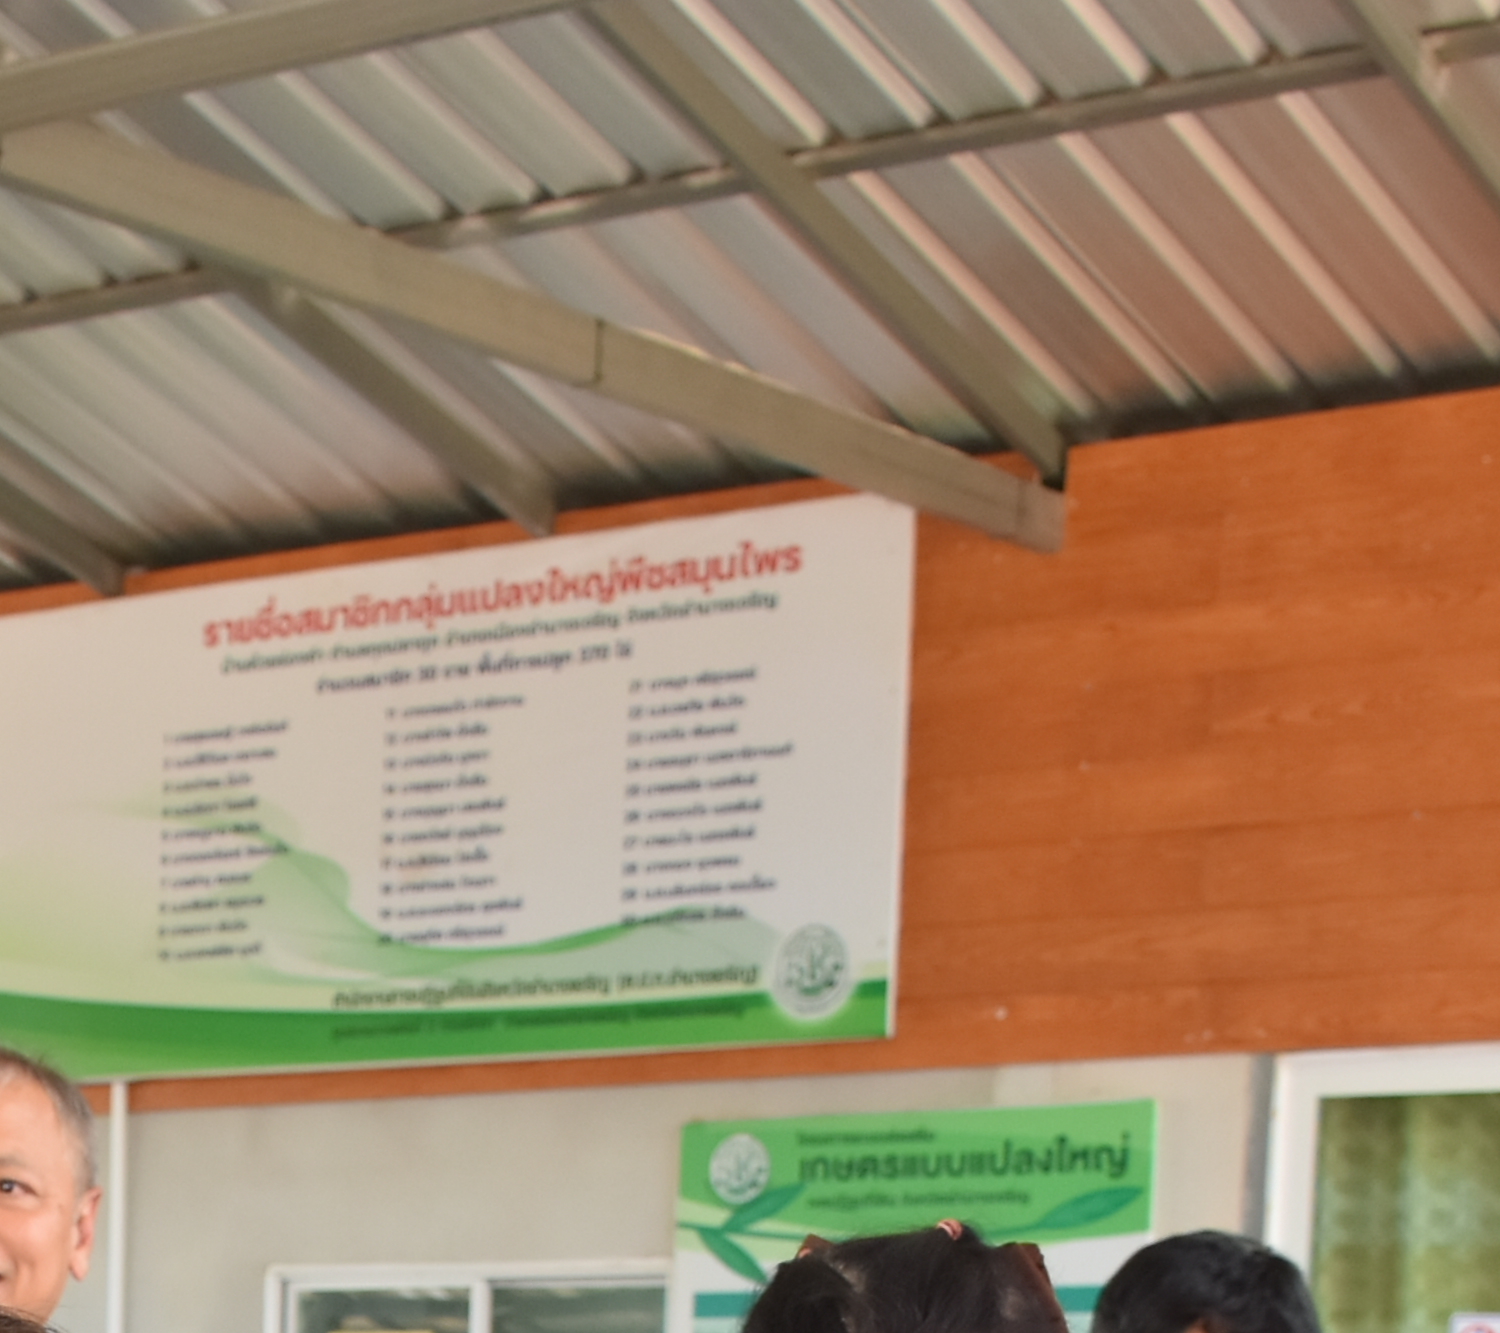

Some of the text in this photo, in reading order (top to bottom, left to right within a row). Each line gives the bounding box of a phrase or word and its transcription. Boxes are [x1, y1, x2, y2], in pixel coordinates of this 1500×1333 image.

[798, 1130, 1131, 1185] เกษตรแบบแปลงใหญ่
